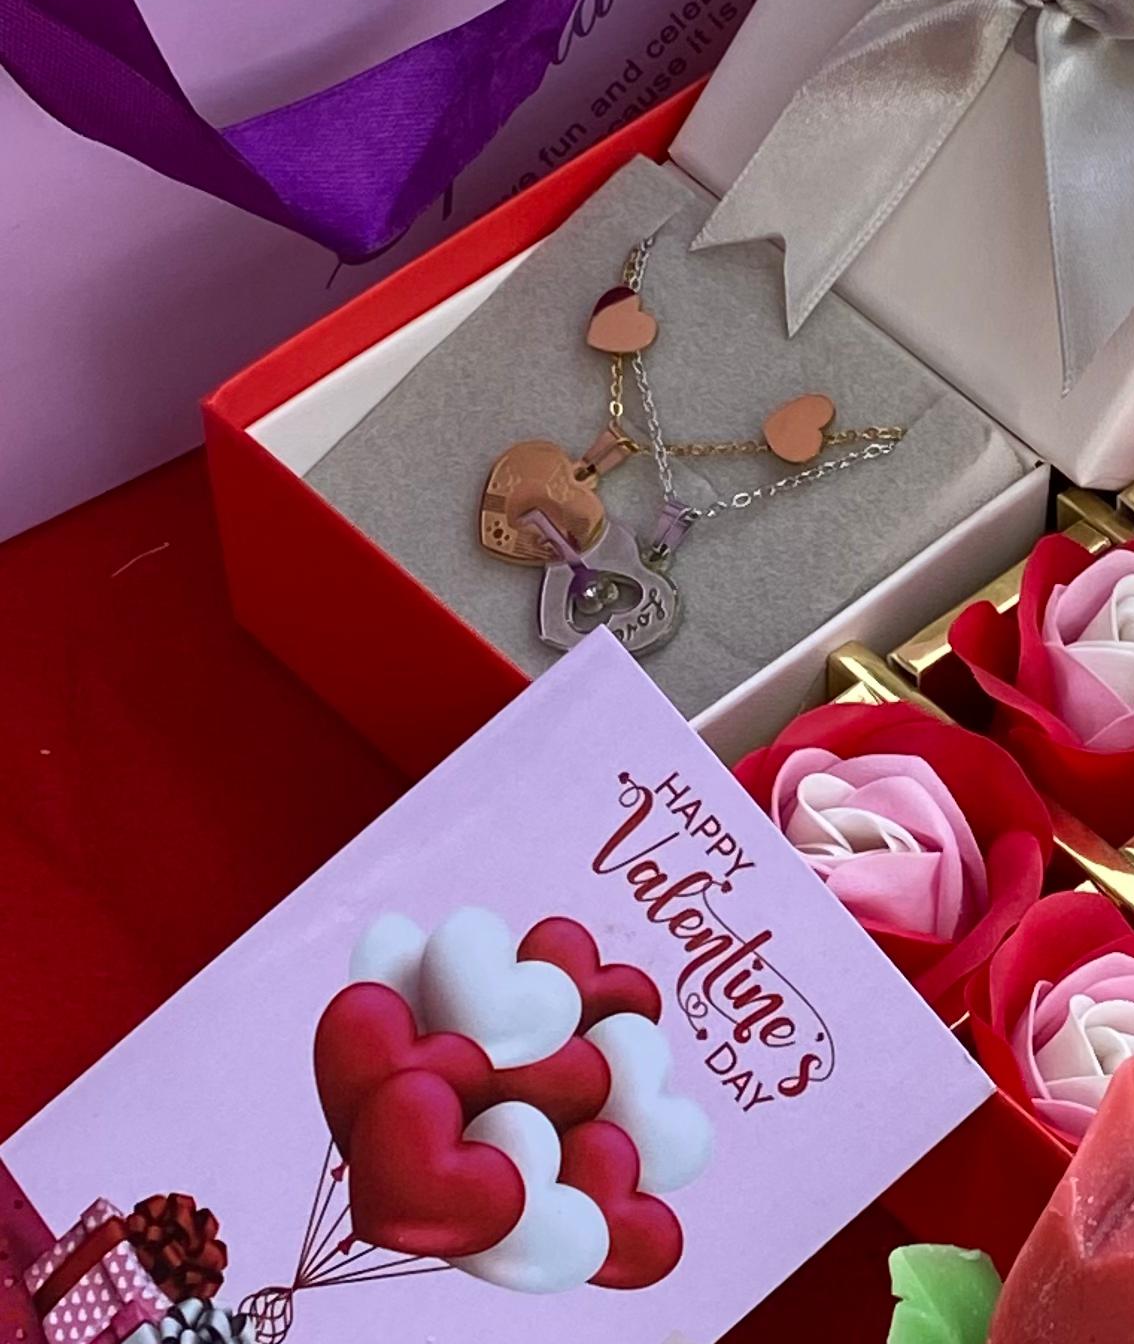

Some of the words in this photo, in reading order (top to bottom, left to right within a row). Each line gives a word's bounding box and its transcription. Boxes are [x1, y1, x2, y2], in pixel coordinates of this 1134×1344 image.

[686, 29, 712, 55] it
[708, 2, 738, 30] is
[538, 123, 588, 168] fun
[591, 59, 643, 117] and
[654, 771, 757, 878] HAPPY
[591, 771, 836, 1098] Valentine's
[703, 1040, 776, 1113] DAY
